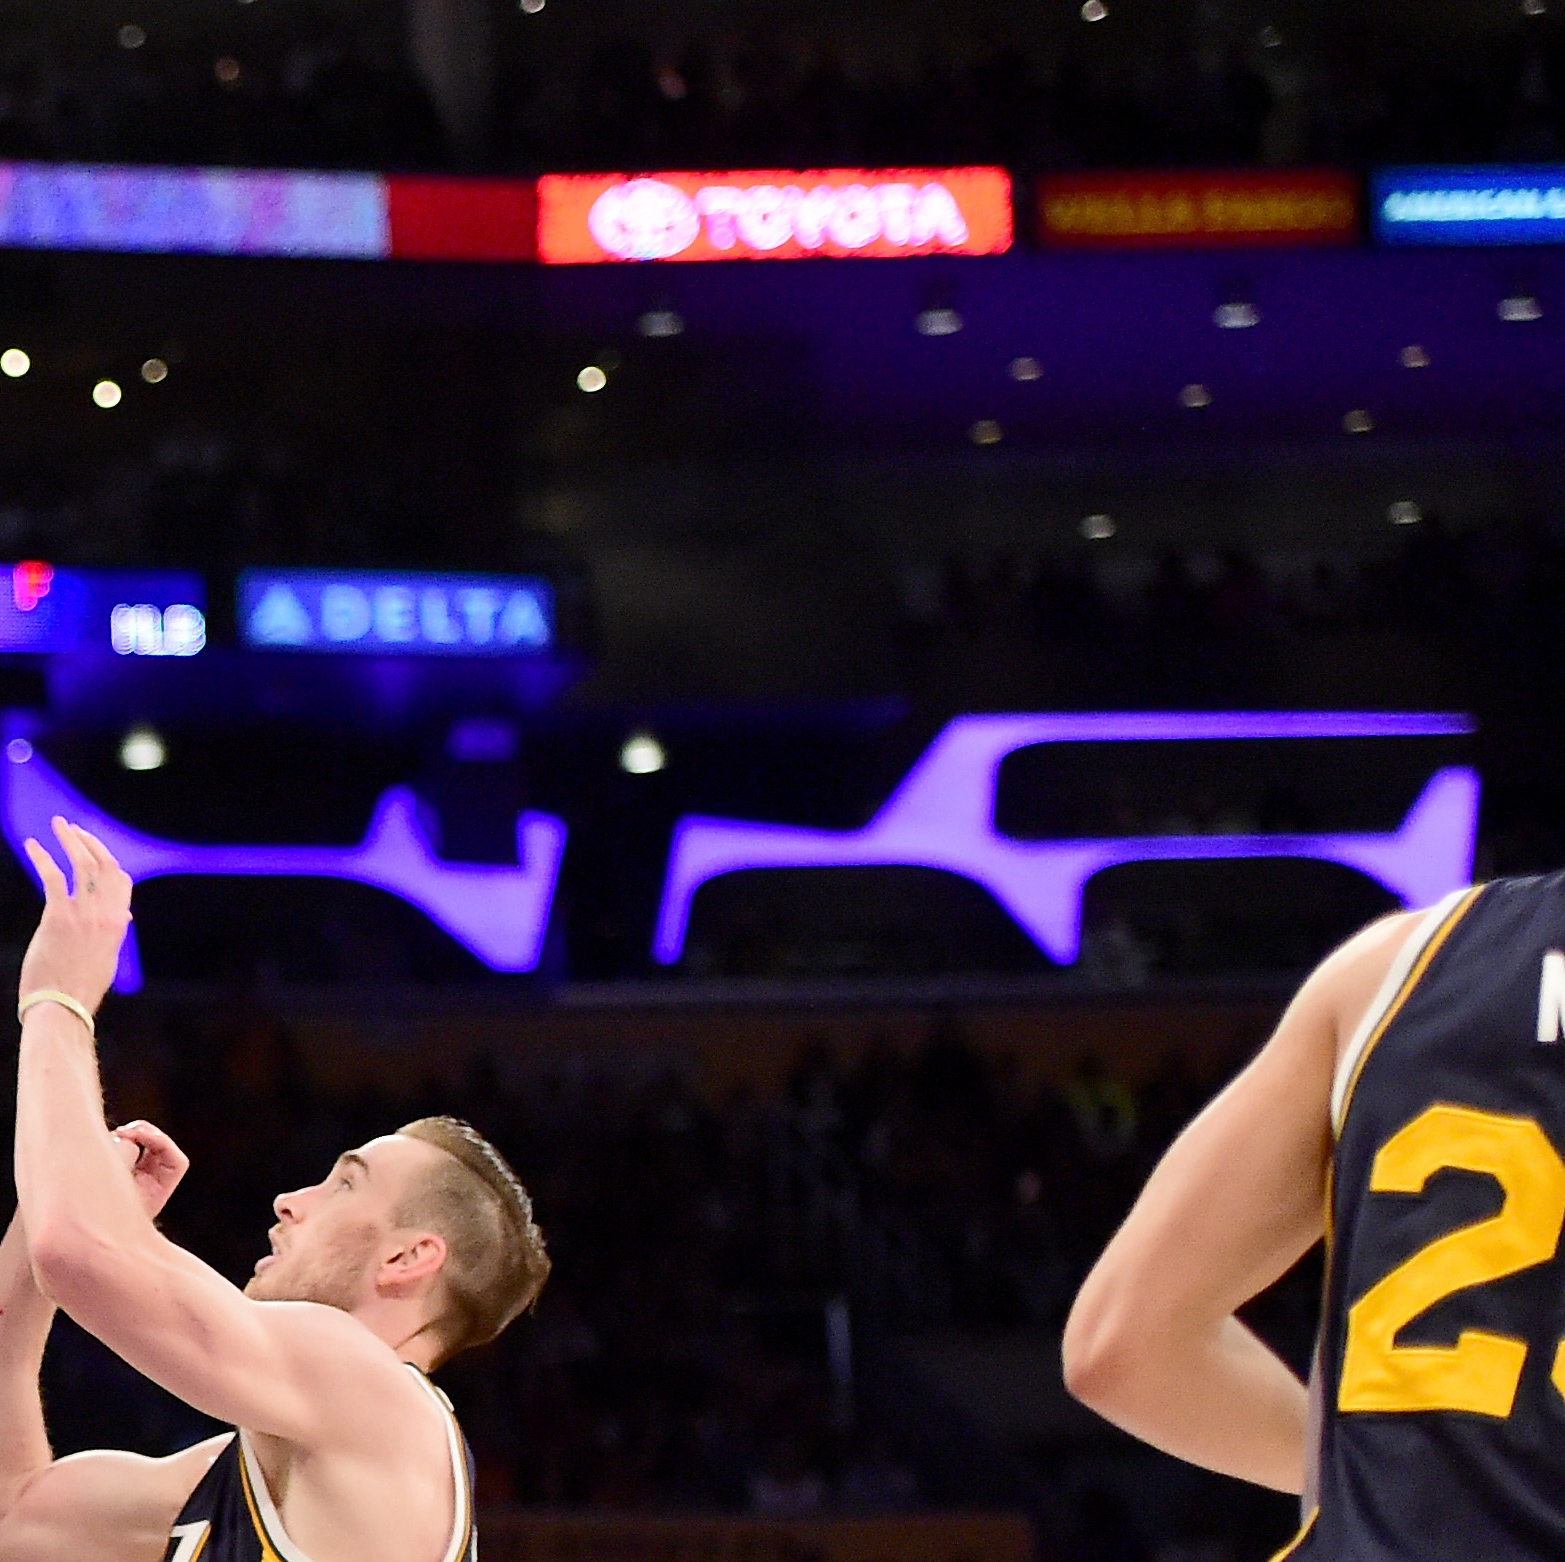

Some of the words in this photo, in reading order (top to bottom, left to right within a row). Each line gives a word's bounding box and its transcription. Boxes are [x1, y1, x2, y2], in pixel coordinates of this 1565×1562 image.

[695, 182, 969, 250] TOYOTA
[322, 584, 551, 646] DELTA
[1336, 1103, 1565, 1418] 2
